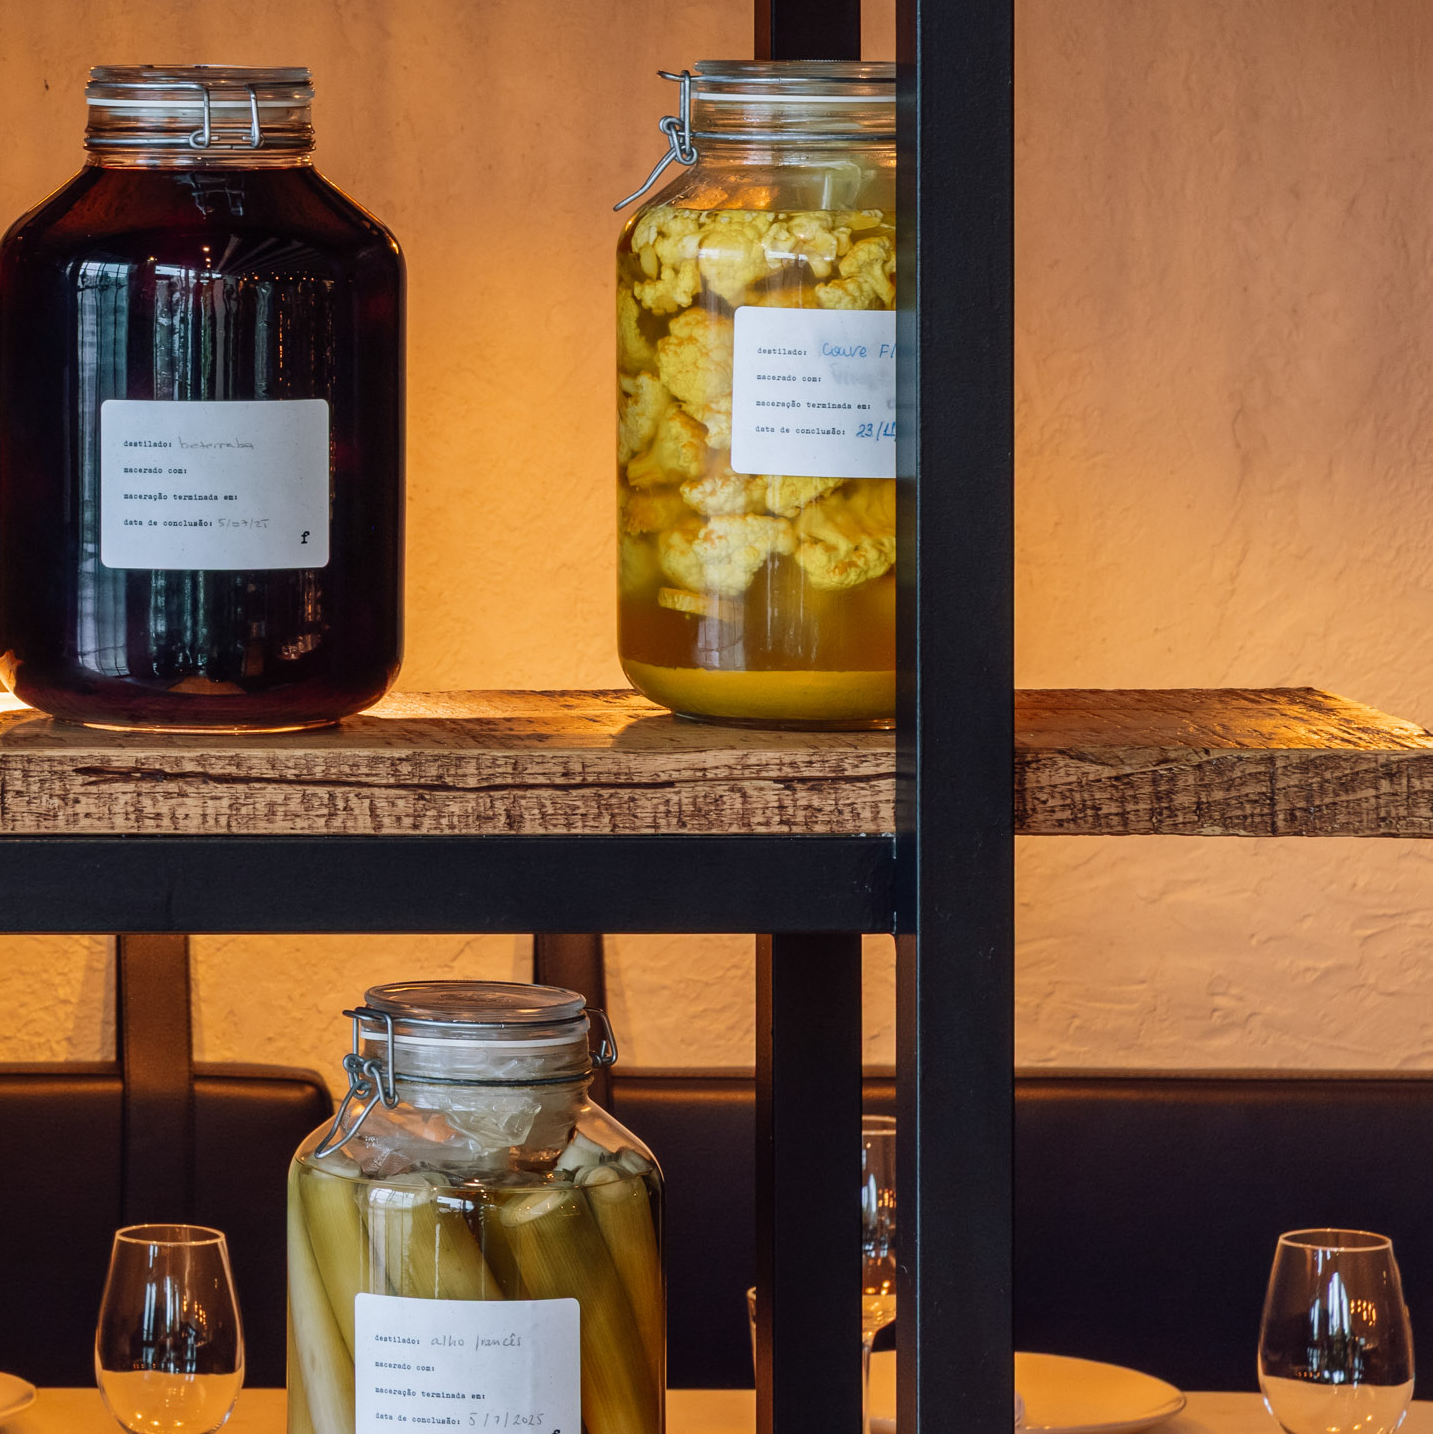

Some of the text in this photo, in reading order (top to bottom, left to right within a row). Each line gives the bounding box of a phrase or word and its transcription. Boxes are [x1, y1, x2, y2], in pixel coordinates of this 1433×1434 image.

[756, 341, 868, 359] destilado: Couve
[756, 374, 797, 382] macerado
[755, 399, 802, 410] maceração
[805, 401, 852, 410] terminada
[754, 425, 846, 436] data de conclusão:
[123, 439, 173, 449] destilado:
[122, 466, 164, 475] macerado
[123, 491, 169, 502] maceração
[172, 493, 219, 501] terminada
[123, 518, 144, 527] data
[147, 519, 158, 527] de
[162, 518, 213, 528] conclusão:
[300, 529, 311, 545] f
[374, 1333, 421, 1345] destilado:
[430, 1334, 465, 1347] alho
[374, 1361, 412, 1371] macerado
[374, 1387, 417, 1398] maceração
[420, 1390, 466, 1400] terminada
[375, 1411, 461, 1426] data de conclusão:
